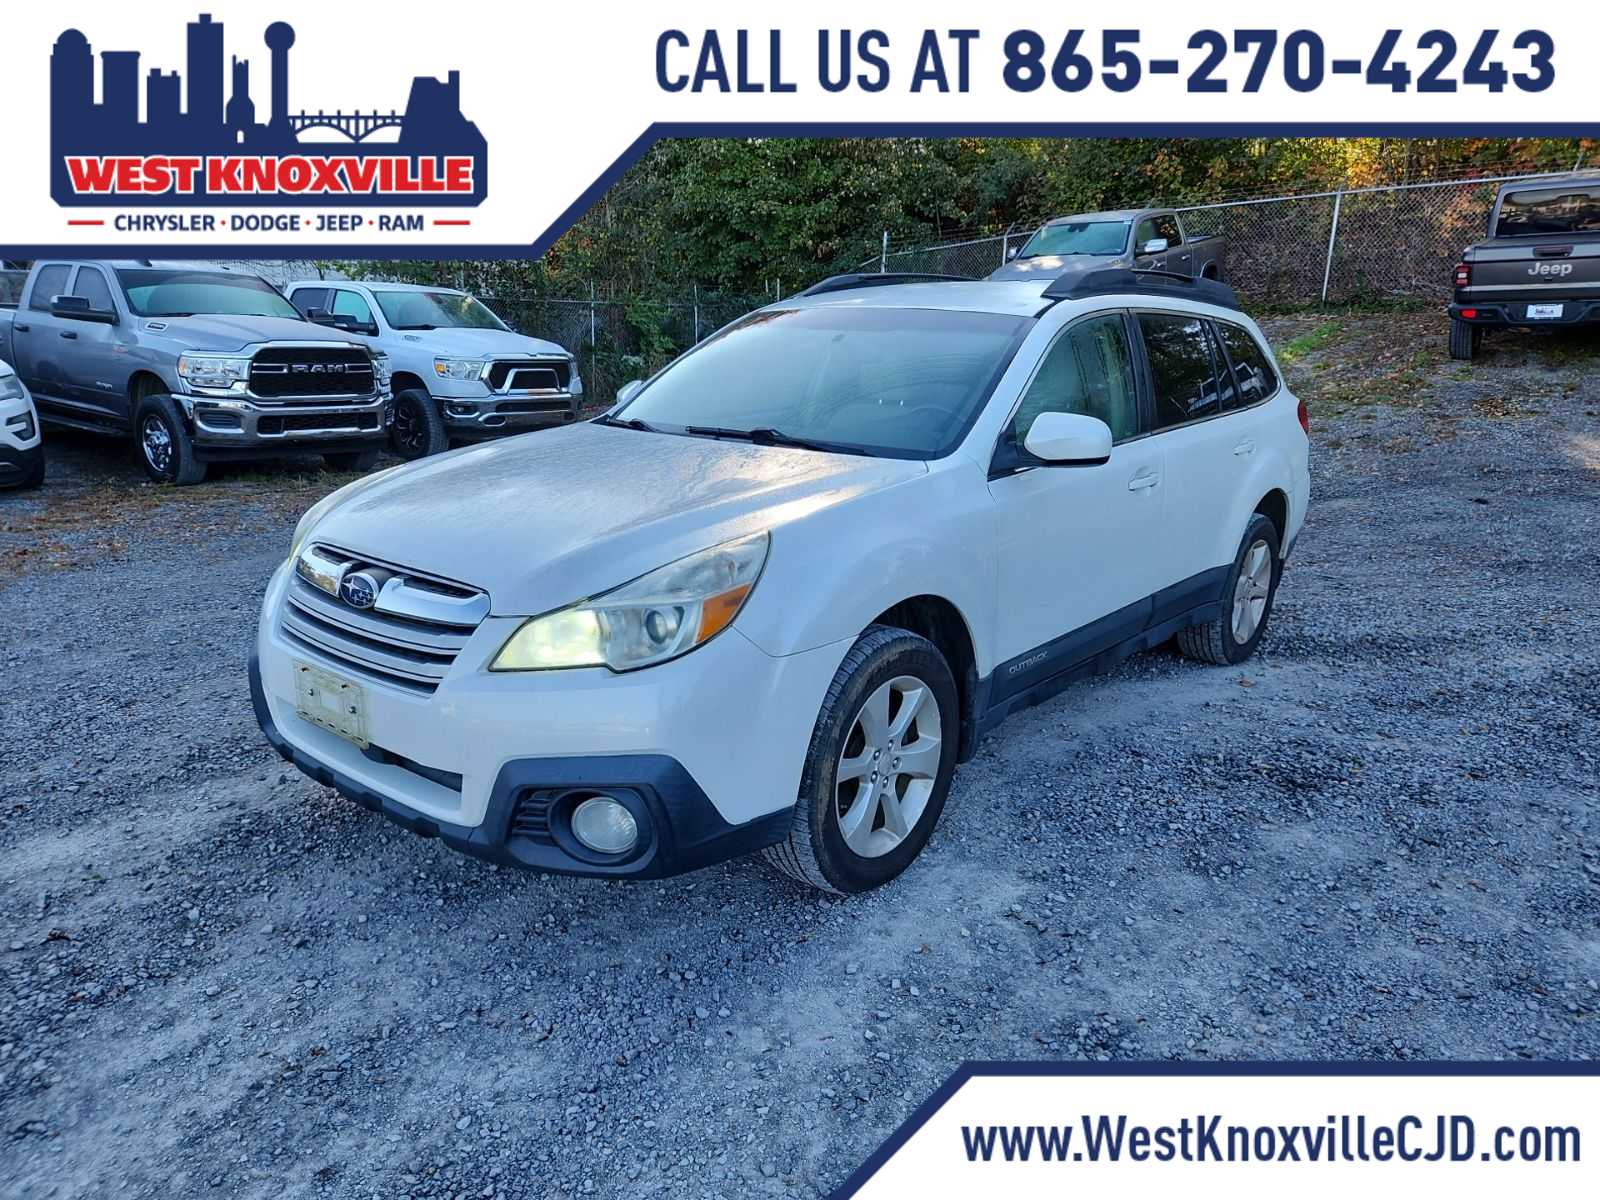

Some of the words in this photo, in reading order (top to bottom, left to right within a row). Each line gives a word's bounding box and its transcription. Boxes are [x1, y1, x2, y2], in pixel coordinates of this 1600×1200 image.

[1528, 262, 1573, 277] Jeep
[291, 364, 344, 373] RAM
[1009, 651, 1048, 674] OUTBACK
